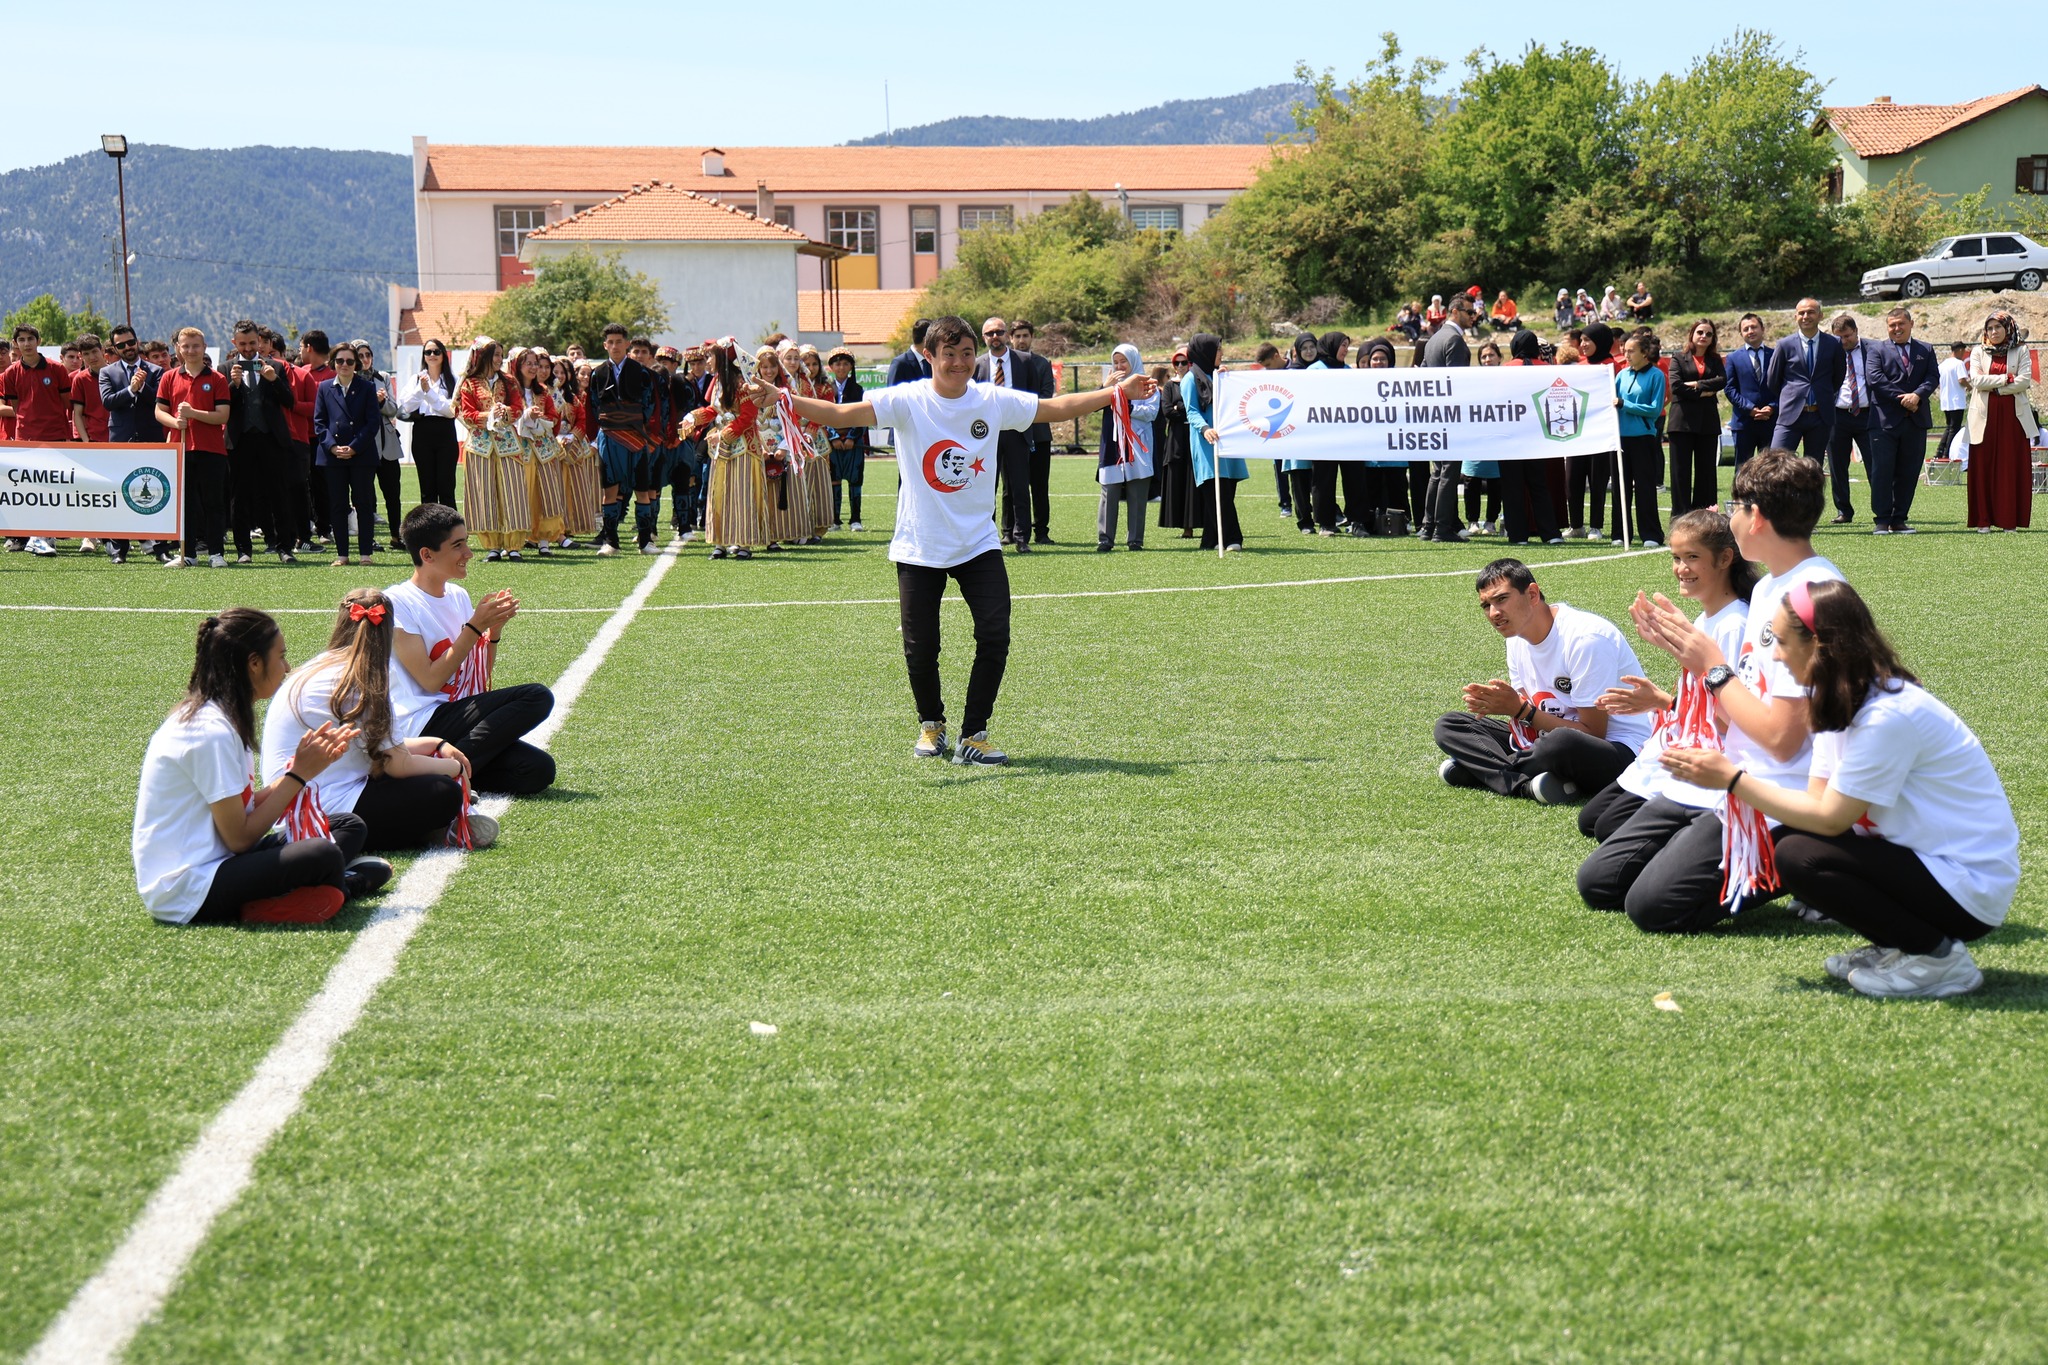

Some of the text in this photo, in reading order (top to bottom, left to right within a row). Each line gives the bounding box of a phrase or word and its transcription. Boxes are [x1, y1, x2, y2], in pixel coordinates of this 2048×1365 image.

[1377, 376, 1452, 402] ÇAMELİ
[1307, 400, 1527, 423] ANADOLU İMAM HATİP
[1387, 428, 1448, 450] LİSESİ
[7, 467, 75, 486] ÇAMELİ
[66, 490, 117, 508] LİSESİ
